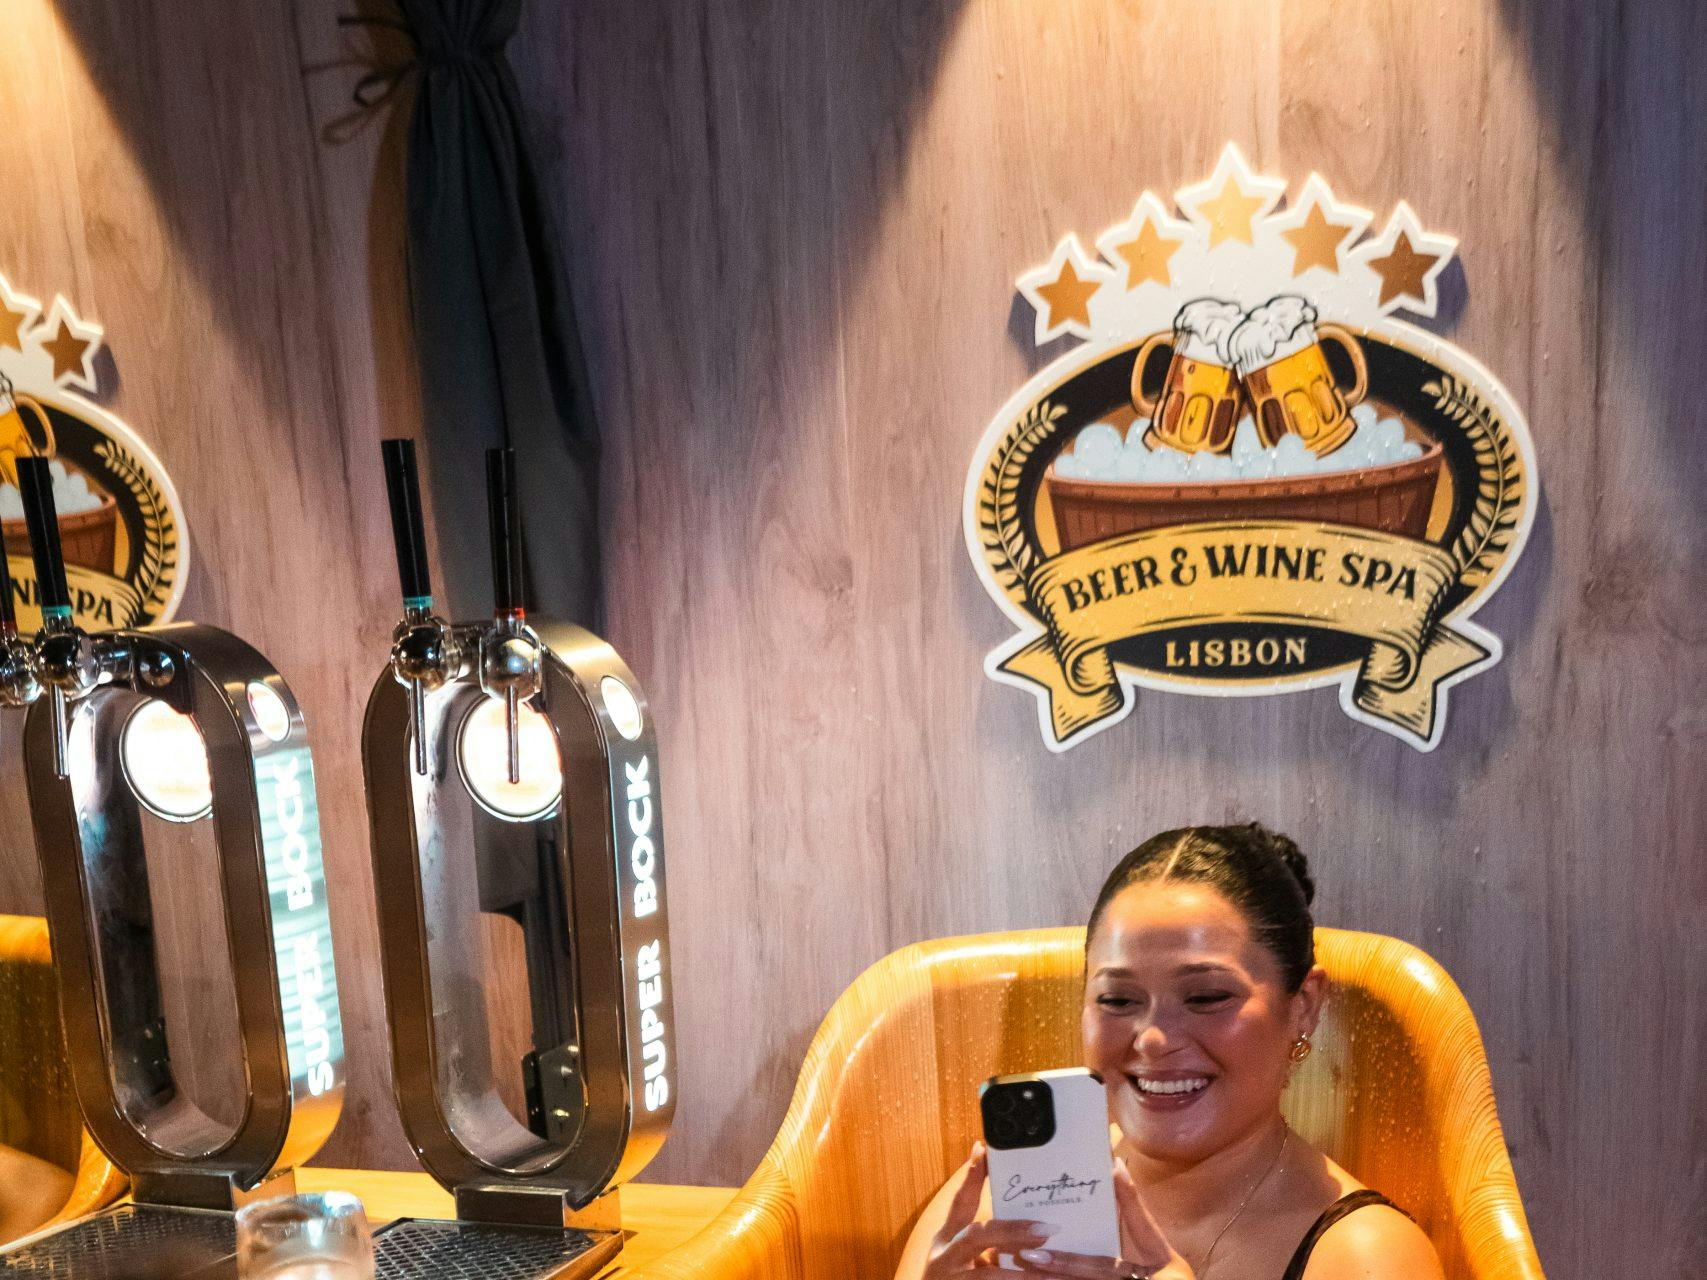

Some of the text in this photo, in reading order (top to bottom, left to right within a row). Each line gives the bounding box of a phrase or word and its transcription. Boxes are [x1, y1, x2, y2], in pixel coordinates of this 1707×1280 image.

[69, 586, 114, 625] PA
[1061, 544, 1416, 613] BEER & WINE SPA
[1165, 638, 1308, 667] LISBON
[272, 756, 334, 1096] SUPER BOCK
[625, 755, 669, 1112] SUPER BOCK
